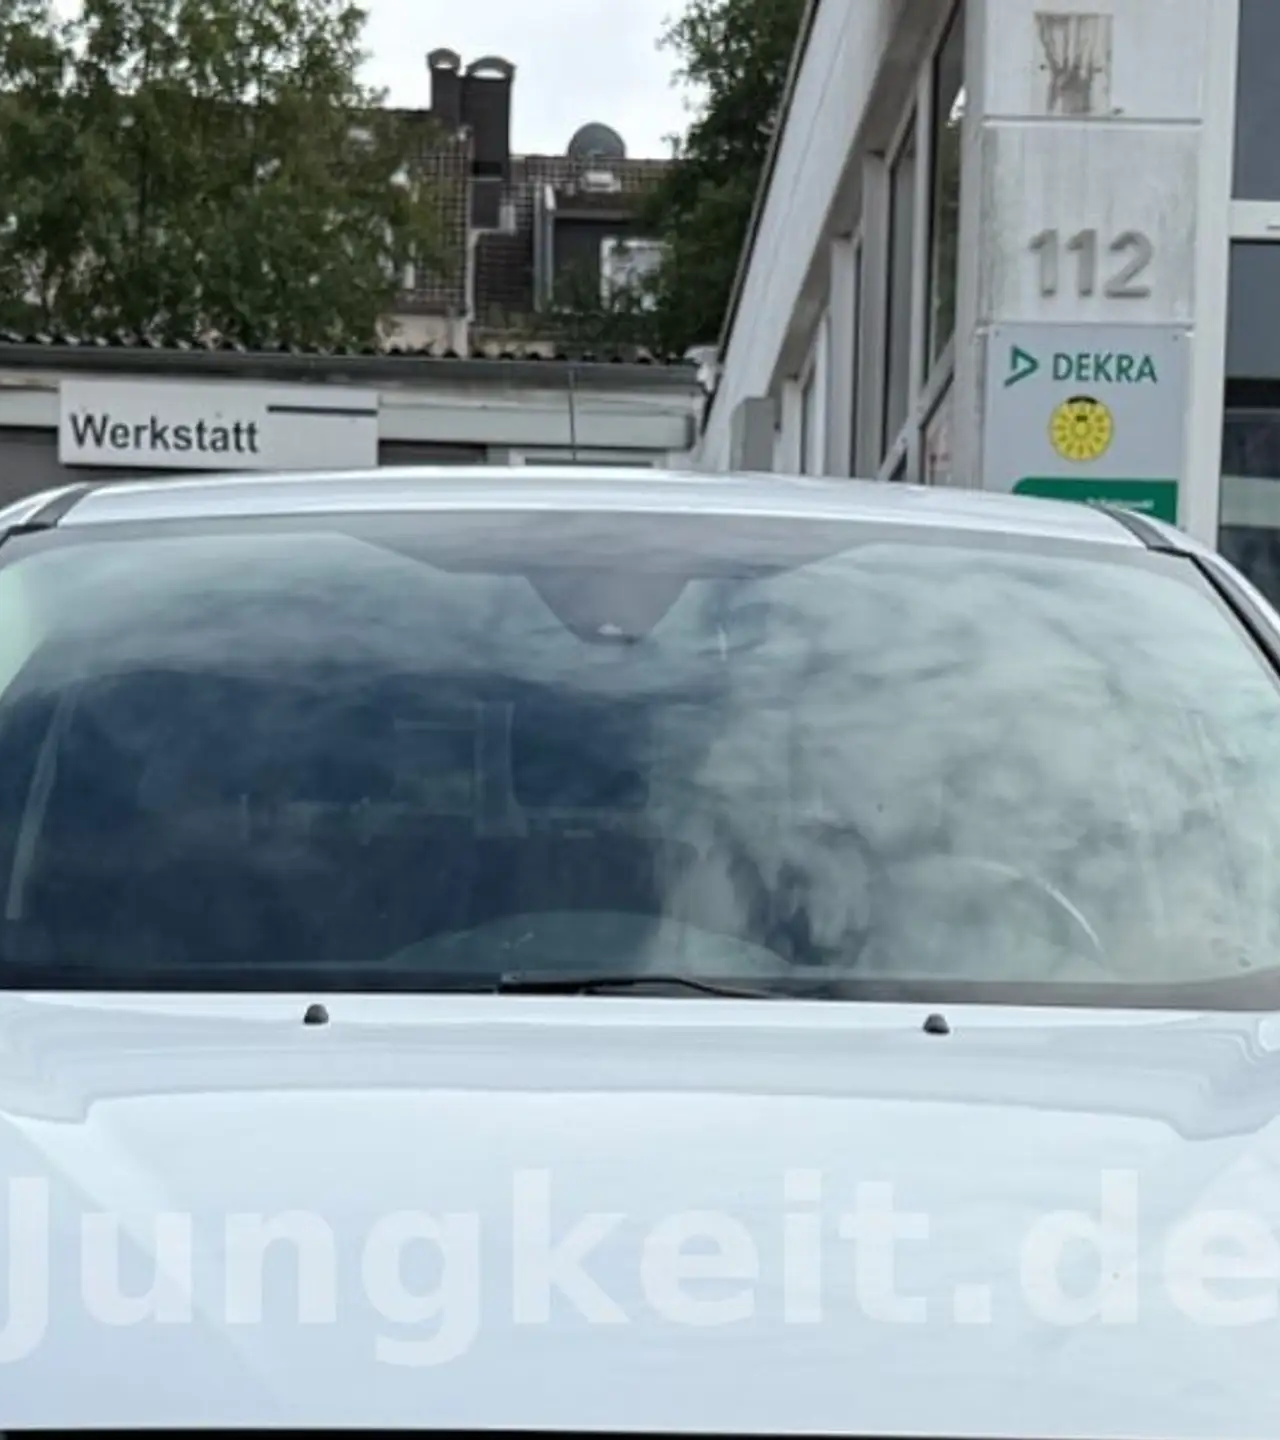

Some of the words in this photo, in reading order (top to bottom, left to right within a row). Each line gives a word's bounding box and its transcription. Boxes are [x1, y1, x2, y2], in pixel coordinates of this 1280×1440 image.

[1027, 228, 1154, 300] 112
[1052, 352, 1158, 384] DEKRA
[70, 413, 259, 454] Werkstatt
